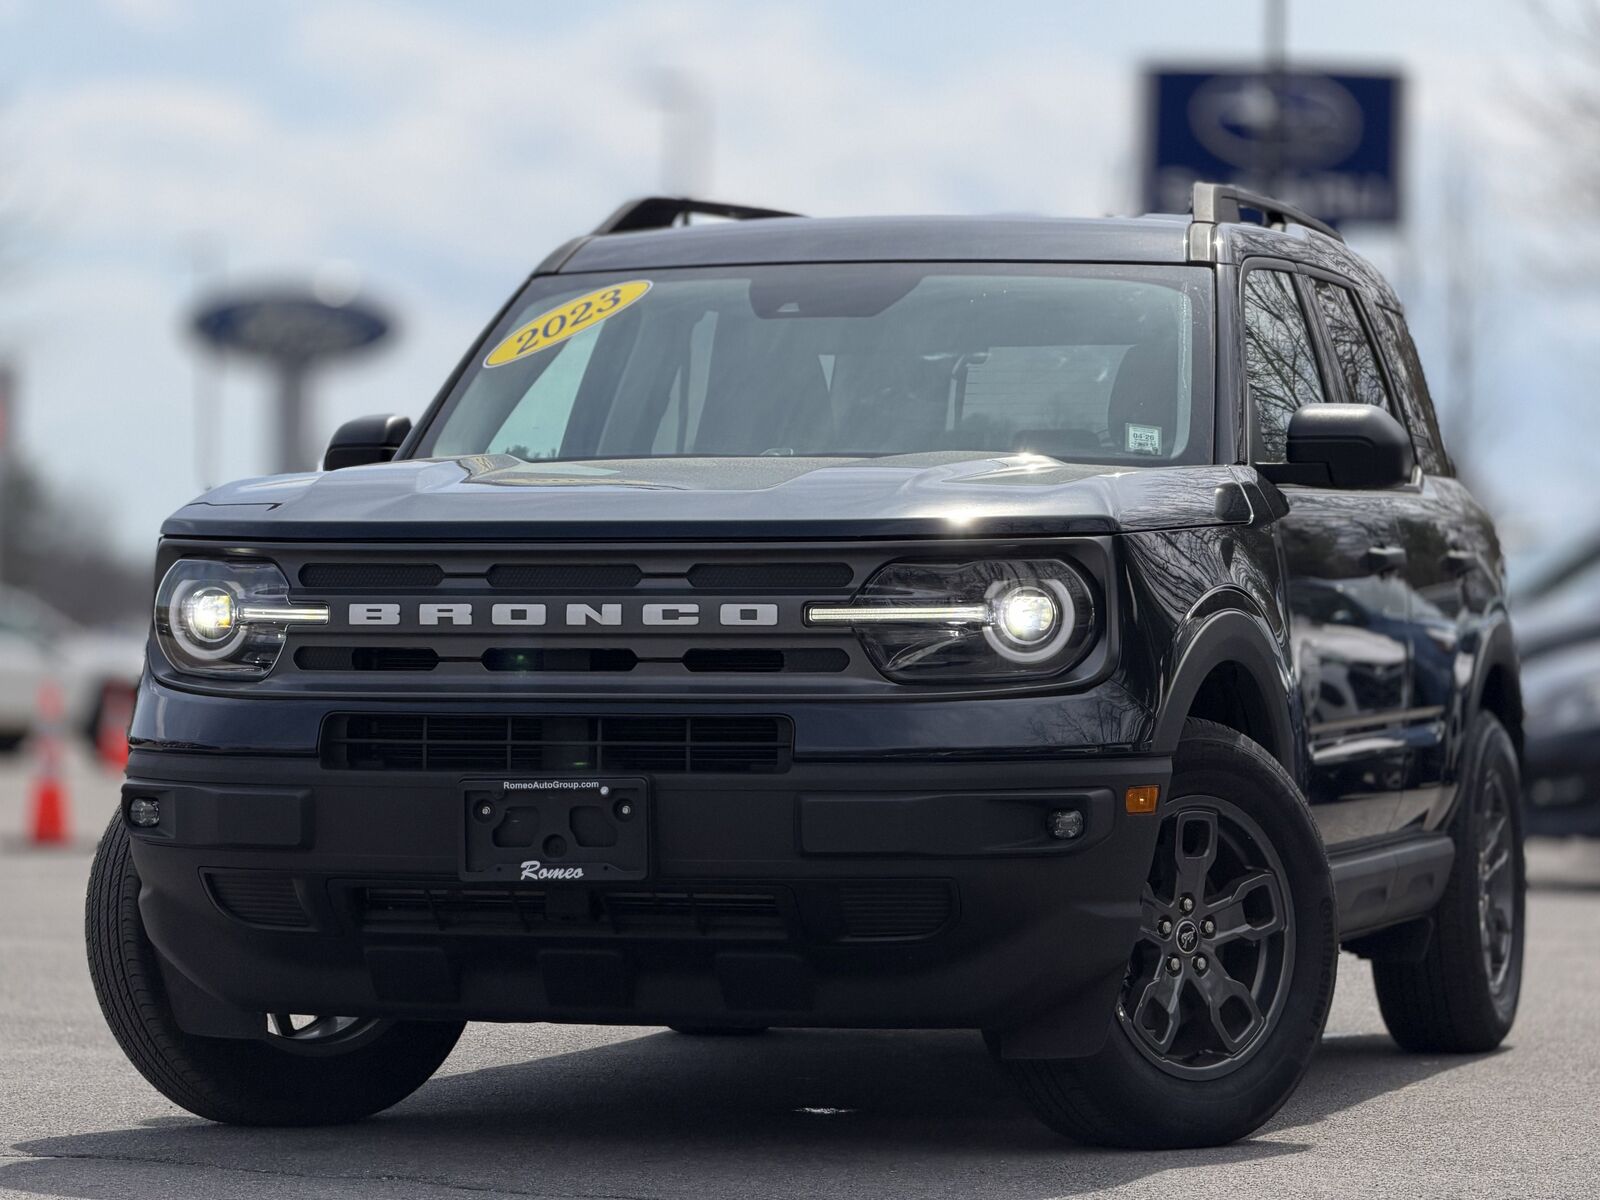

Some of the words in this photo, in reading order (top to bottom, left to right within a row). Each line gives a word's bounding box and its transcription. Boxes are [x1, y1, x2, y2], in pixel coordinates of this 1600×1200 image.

[516, 288, 622, 355] 2023
[348, 603, 778, 626] BRONCO
[503, 780, 599, 790] RomeoAutoGroup.com
[520, 860, 584, 881] Romeo
